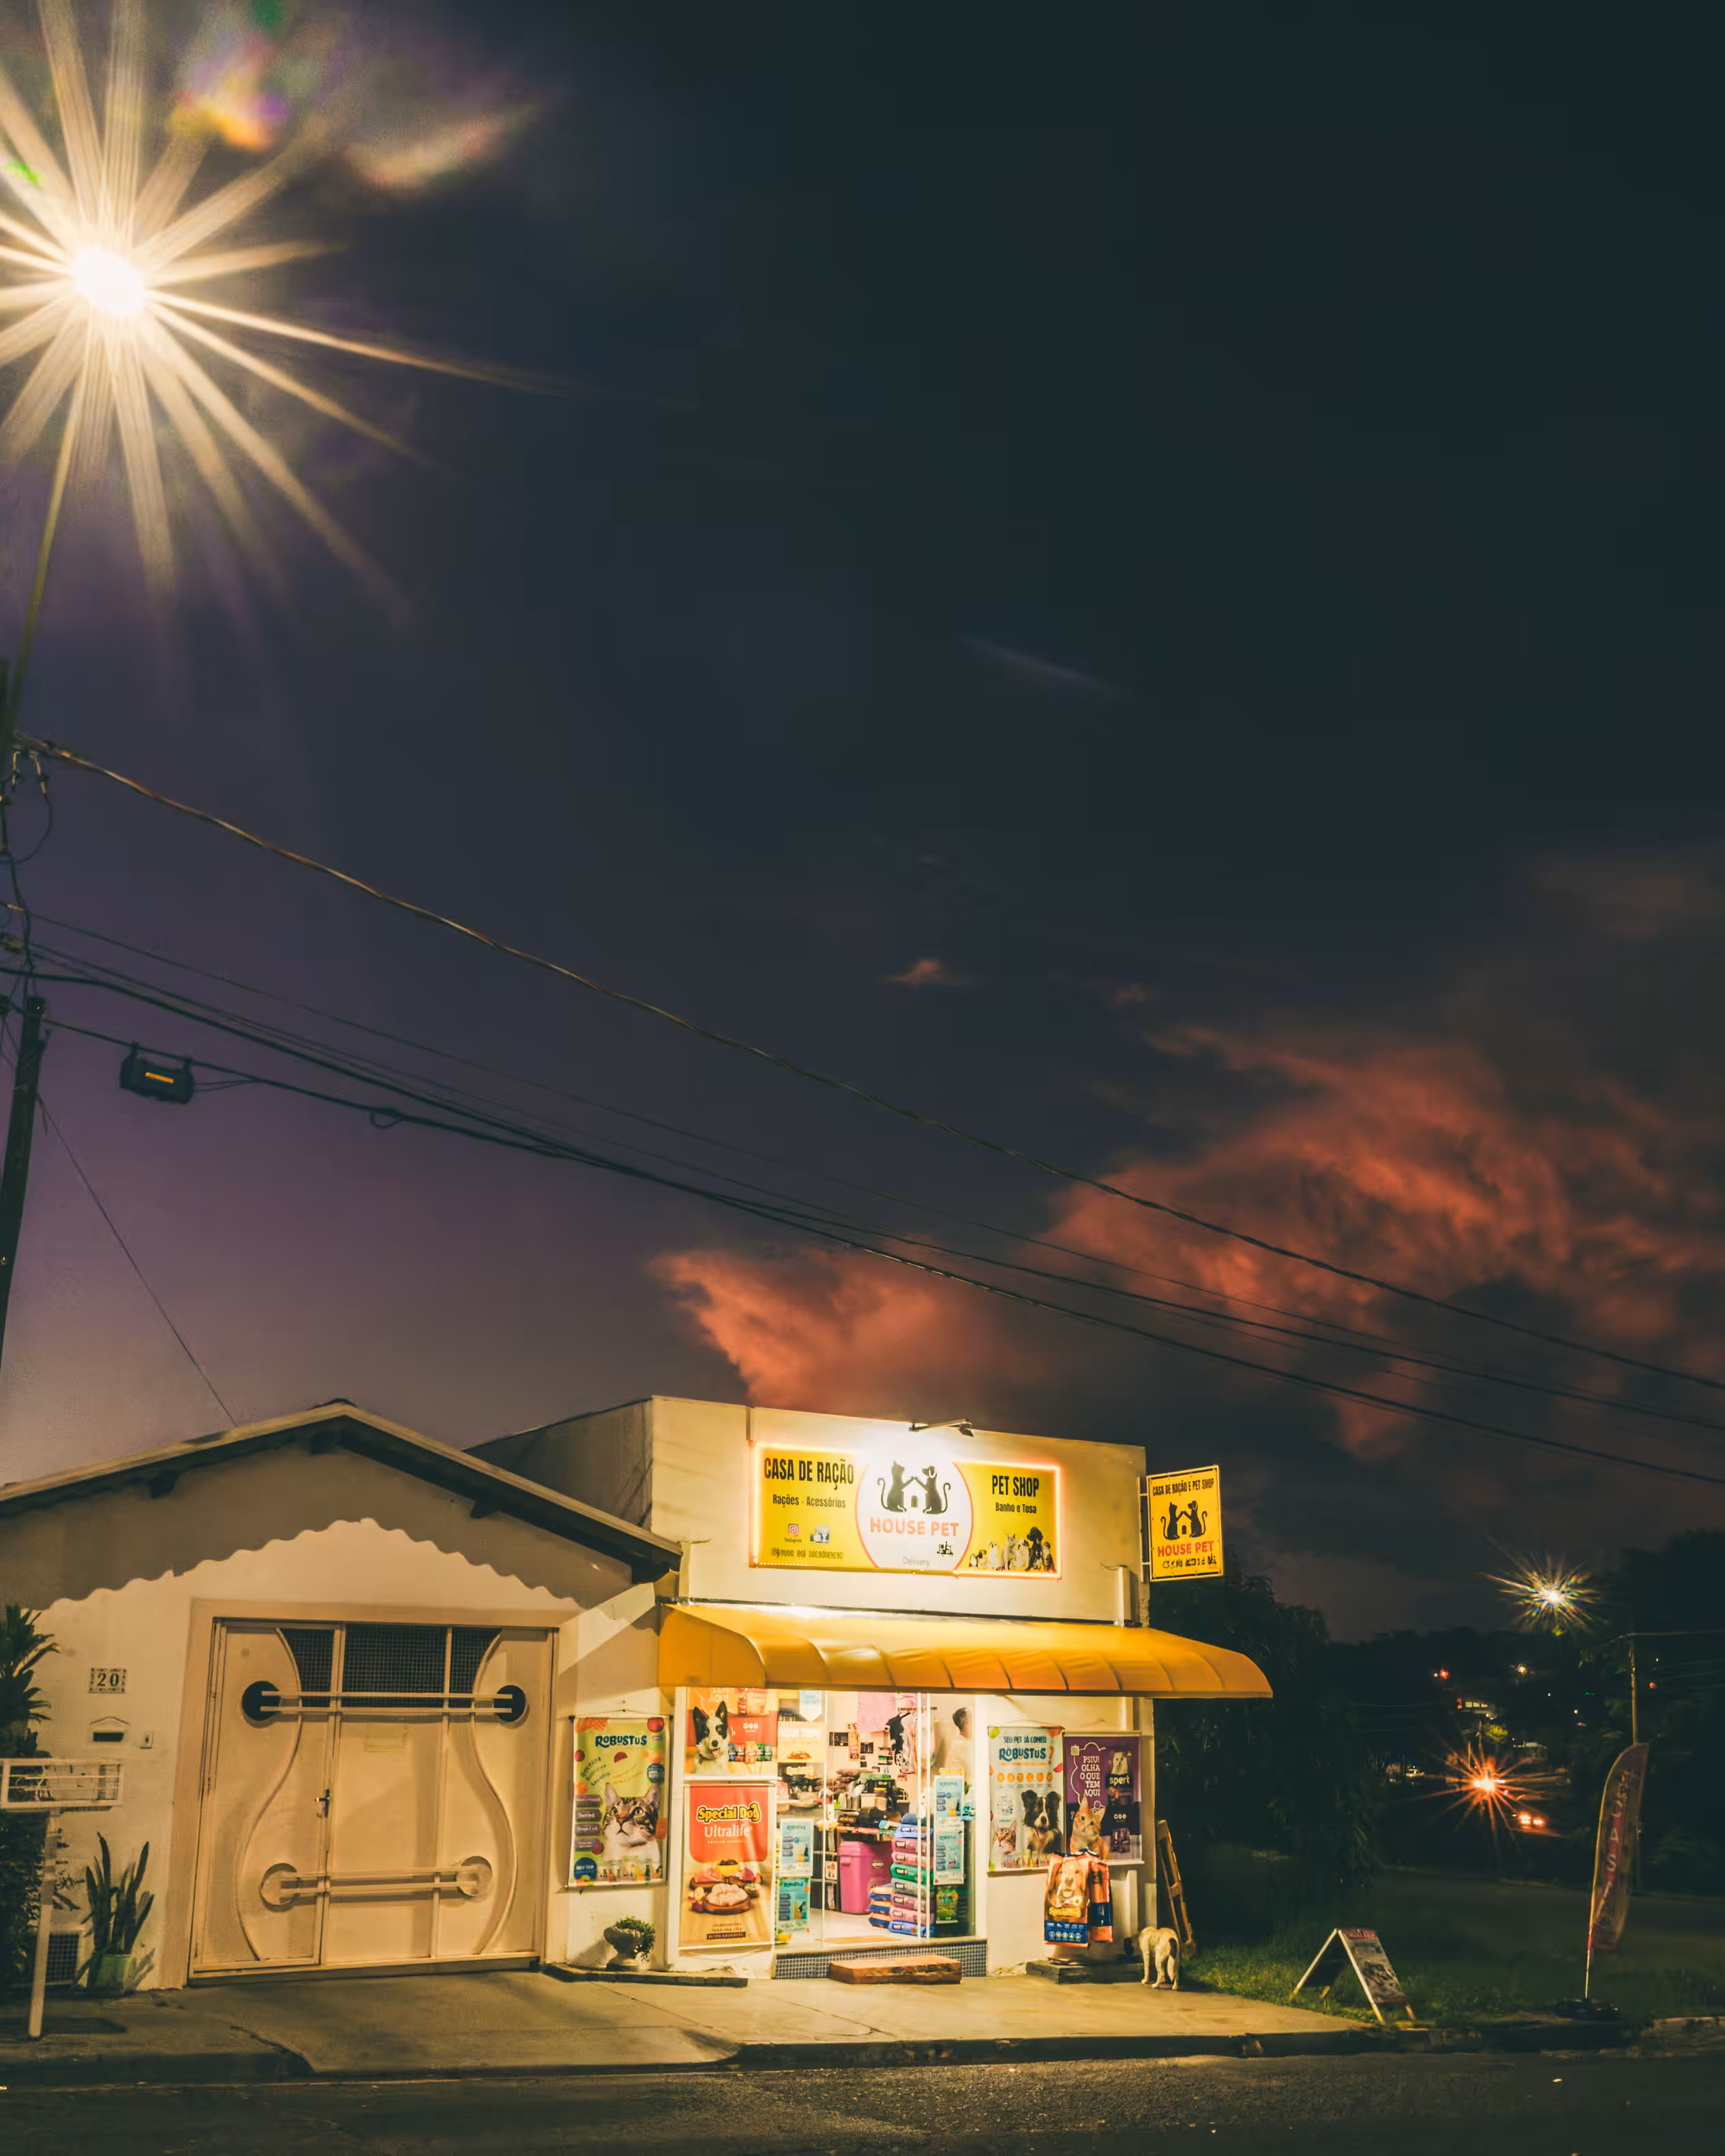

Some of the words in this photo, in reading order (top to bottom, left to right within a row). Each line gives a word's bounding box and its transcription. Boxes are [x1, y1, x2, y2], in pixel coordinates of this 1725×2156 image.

[764, 1457, 795, 1480] CASA
[798, 1460, 813, 1482] DE
[817, 1458, 854, 1491] RAÇÃO
[992, 1475, 1010, 1495] PET
[1013, 1476, 1040, 1497] SHOP
[1153, 1486, 1164, 1496] CASA
[1165, 1484, 1171, 1495] DE
[1188, 1481, 1191, 1491] E
[1192, 1480, 1201, 1491] PET
[1202, 1478, 1214, 1489] SHOP
[772, 1494, 799, 1508] Rações
[807, 1496, 846, 1508] Acessórios
[995, 1502, 1015, 1512] Banho
[1017, 1504, 1021, 1513] e
[1022, 1503, 1037, 1514] Tosa
[870, 1516, 926, 1536] HOUSE
[931, 1521, 959, 1537] PET
[1157, 1543, 1192, 1557] HOUSE
[1195, 1540, 1214, 1554] PET
[97, 1673, 119, 1687] 20
[595, 1735, 648, 1748] ROBUSTUS
[1086, 1772, 1100, 1780] QUE
[1085, 1780, 1100, 1788] TEM
[1084, 1788, 1100, 1797] AQUI
[698, 1806, 738, 1823] Special
[739, 1801, 761, 1823] Dog
[704, 1824, 751, 1838] Ultralife
